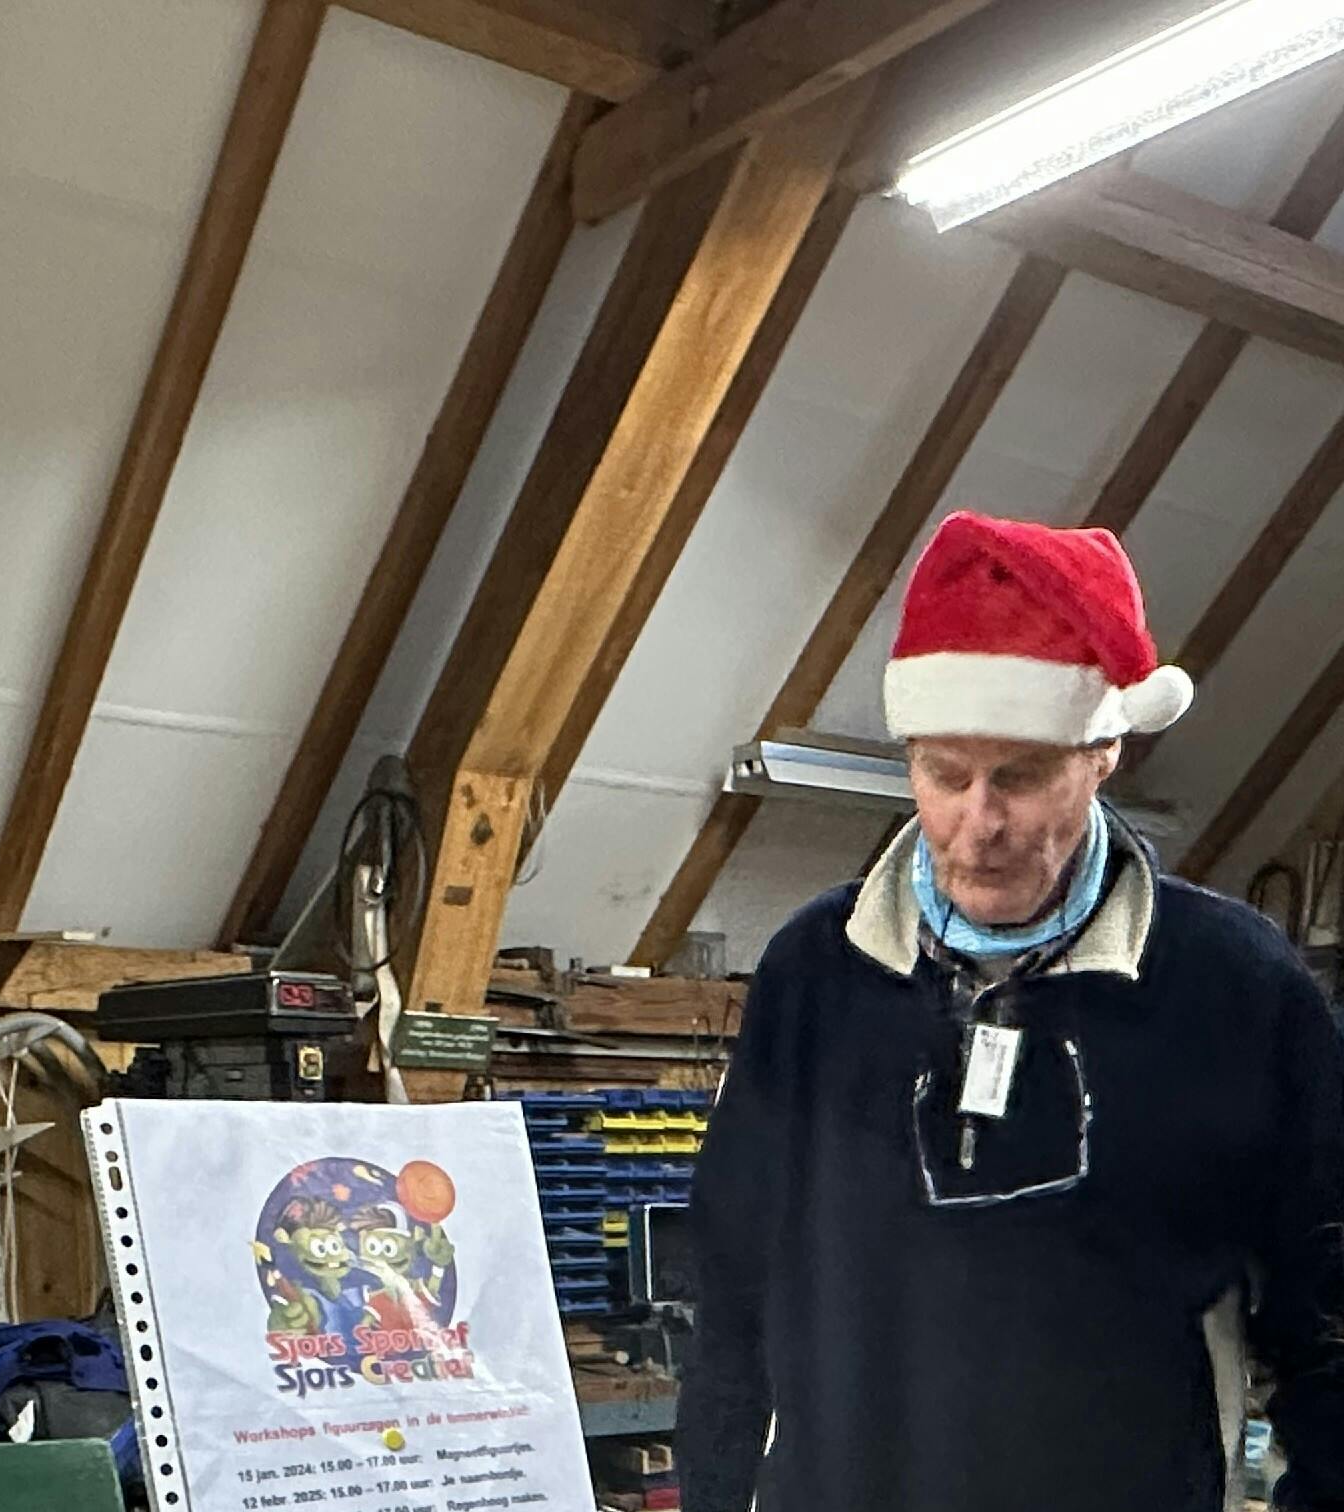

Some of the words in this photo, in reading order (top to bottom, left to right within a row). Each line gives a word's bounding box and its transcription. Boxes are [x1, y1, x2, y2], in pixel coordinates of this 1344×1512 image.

[266, 1330, 346, 1367] Sjors
[274, 1362, 355, 1400] Sjors
[233, 1425, 316, 1444] Workshops
[322, 1416, 401, 1437] figuurzagen
[407, 1414, 419, 1427] in
[426, 1411, 442, 1425] de
[283, 1463, 316, 1478] 2024:
[320, 1458, 352, 1473] 15.00
[366, 1454, 396, 1468] 17.00
[330, 1484, 362, 1499] 15.00
[376, 1479, 408, 1494] 17.00
[441, 1474, 455, 1487] Je
